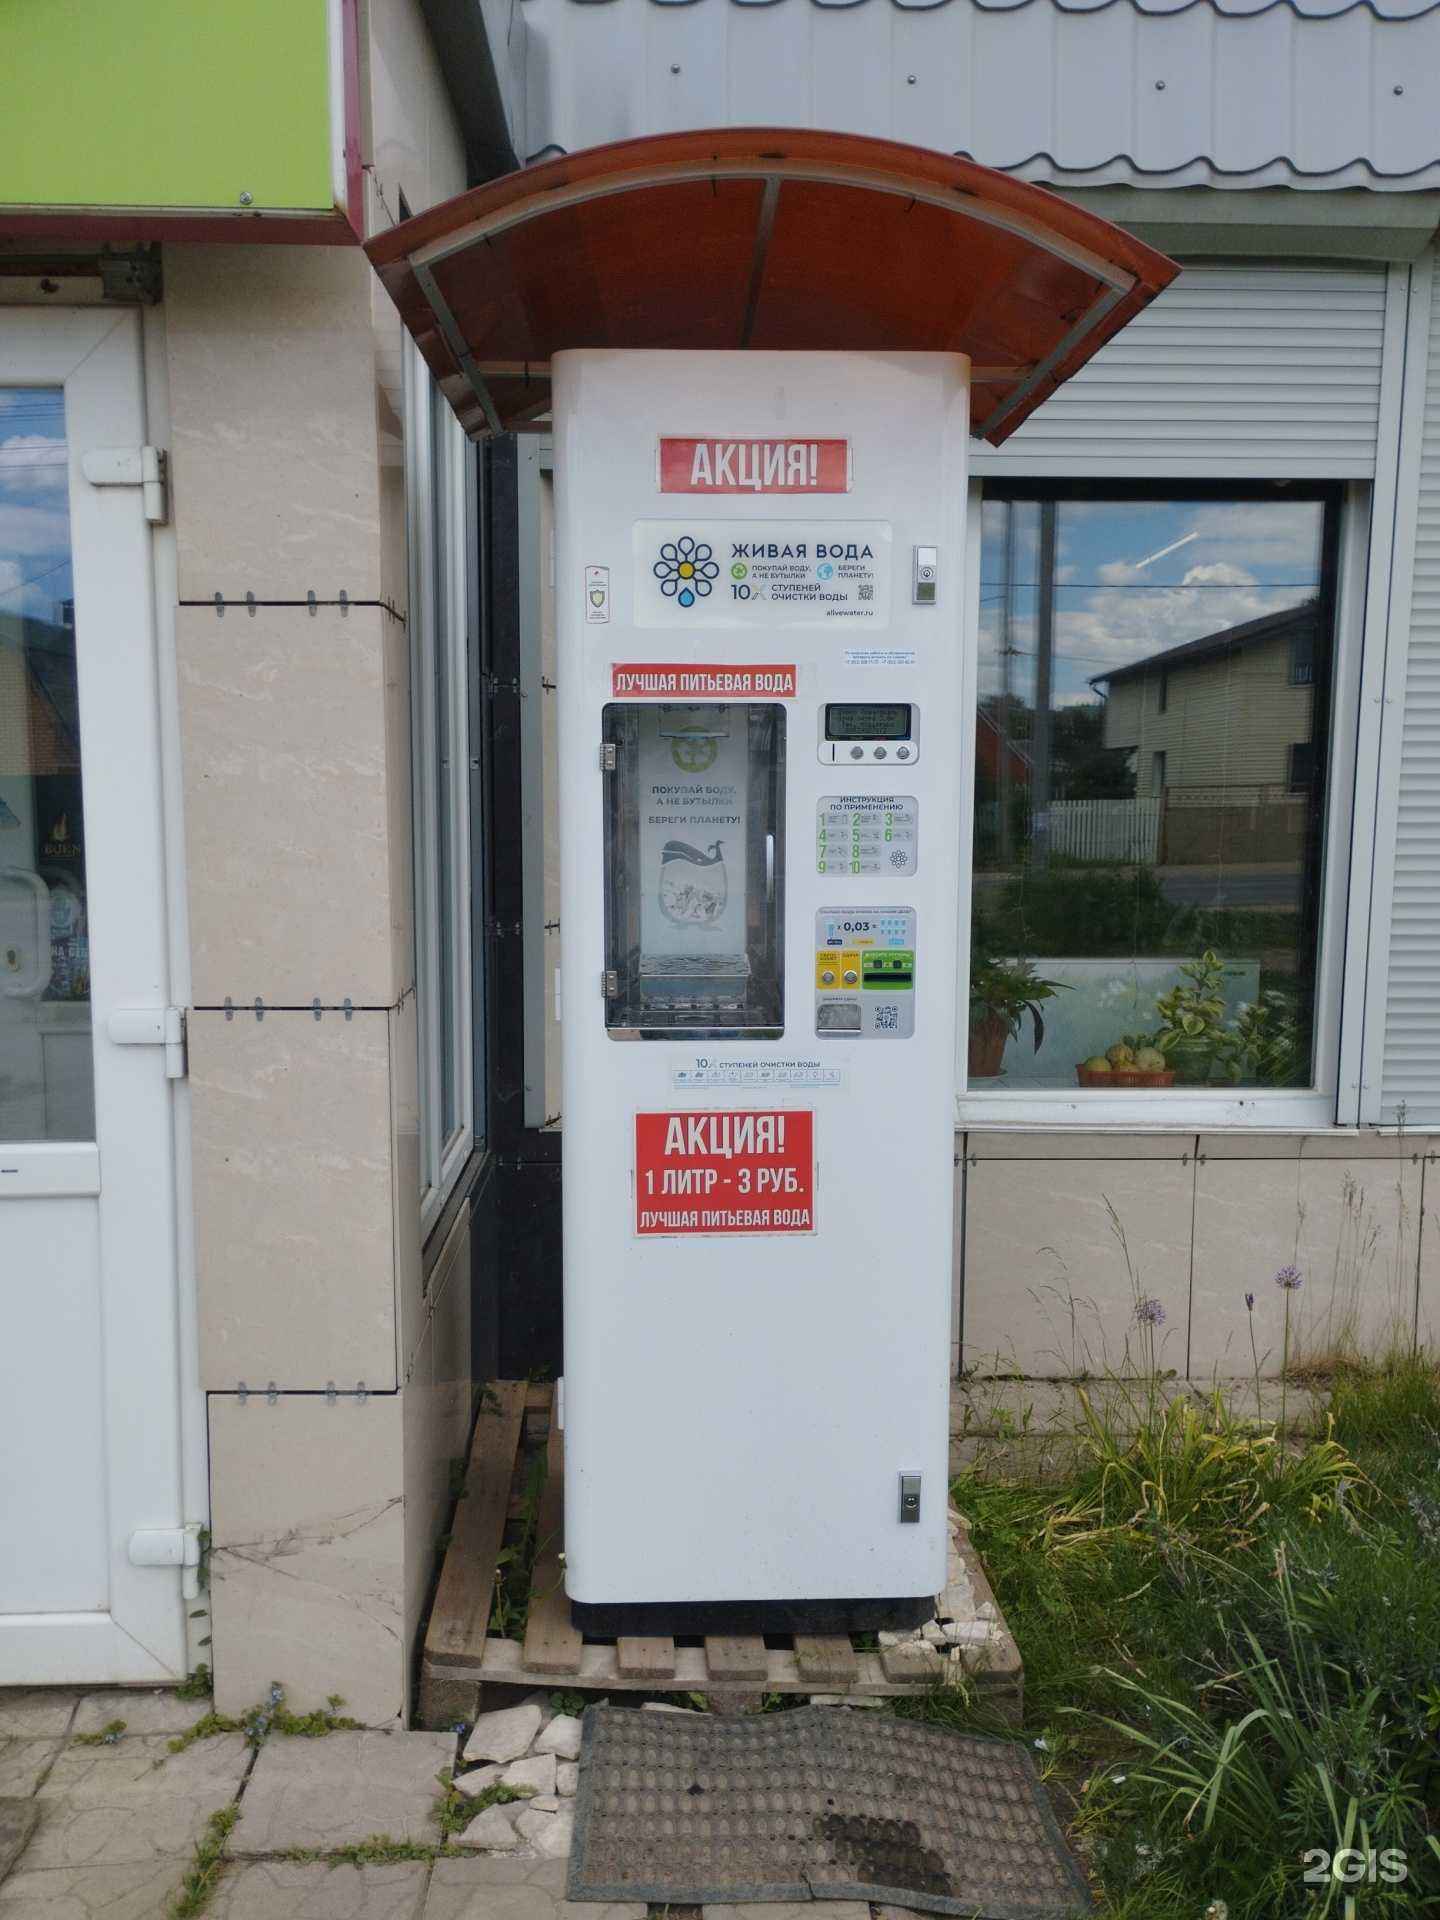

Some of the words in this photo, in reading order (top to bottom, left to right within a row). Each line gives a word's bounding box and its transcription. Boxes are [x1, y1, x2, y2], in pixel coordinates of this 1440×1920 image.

[690, 443, 818, 491] АКЦИЯ!
[731, 543, 807, 559] ЖИВАЯ
[816, 543, 873, 560] ВОДА
[752, 564, 787, 572] ПОКУПАЙ
[838, 564, 866, 572] БЕРЕГИ
[771, 583, 821, 592] СТУПЕНЕЙ
[771, 593, 816, 601] ОЧИСТКИ
[819, 593, 848, 602] ВОДЫ
[826, 609, 874, 617] alivewater.ru
[616, 673, 676, 691] ЛУЧШАЯ
[681, 673, 751, 691] ПИТЬЕВАЯ
[755, 674, 793, 693] ВОДА
[652, 784, 703, 794] ПОКУПАЙ
[656, 798, 664, 806] А
[840, 795, 894, 804] ИНСТРУКЦИЯ
[830, 803, 842, 811] ПО
[844, 803, 904, 811] ПРИМЕНЕНИЮ
[648, 816, 687, 824] БЕРЕГИ
[690, 816, 741, 824] ПЛАНЕТУ!
[819, 813, 825, 826] 1
[852, 813, 860, 826] 2
[885, 813, 892, 826] 3
[819, 829, 826, 842] 4
[852, 829, 860, 842] 5
[885, 829, 892, 842] 6
[819, 845, 827, 858] 7
[852, 845, 860, 858] 8
[819, 861, 826, 874] 9
[849, 861, 860, 874] 10
[843, 921, 870, 932] 0,03
[719, 1060, 758, 1069] СТУПЕНЕЙ
[760, 1060, 796, 1068] ОЧИСТКИ
[797, 1061, 821, 1069] ВОДЫ
[664, 1115, 785, 1159] АКЦИЯ!
[645, 1169, 654, 1194] 1
[660, 1169, 718, 1195] ЛИТР
[738, 1168, 751, 1194] 3
[757, 1167, 804, 1193] РУБ.
[639, 1210, 698, 1228] ЛУЧШАЯ
[701, 1210, 770, 1227] ПИТЬЕВАЯ
[773, 1209, 810, 1227] ВОДА
